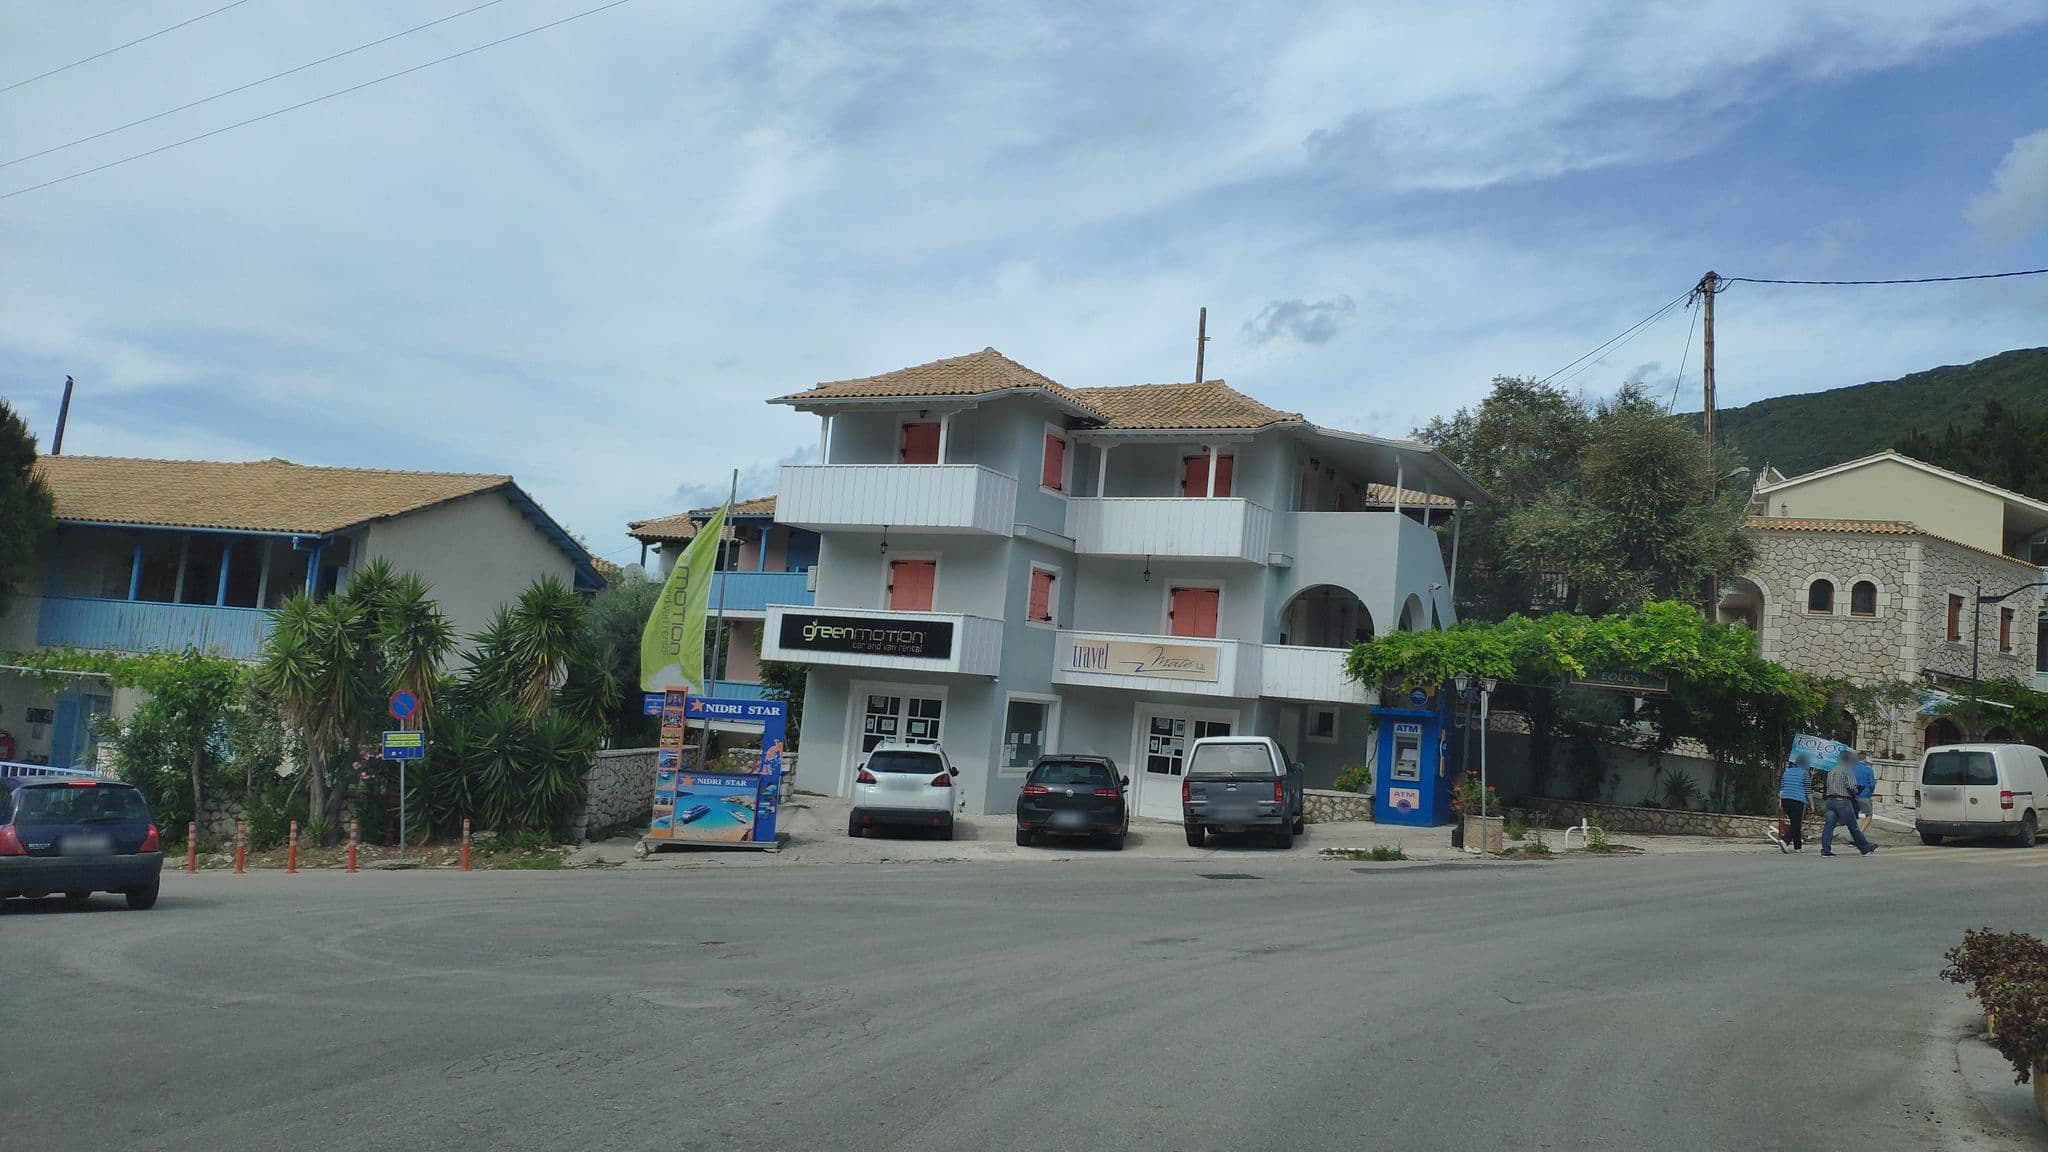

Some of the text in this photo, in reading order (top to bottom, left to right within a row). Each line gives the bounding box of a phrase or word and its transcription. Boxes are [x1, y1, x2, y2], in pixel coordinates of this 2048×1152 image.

[852, 641, 923, 654] car and van rental
[1072, 643, 1109, 670] travel
[705, 703, 780, 716] NIDRI STAR
[1396, 724, 1418, 733] ATM
[697, 777, 747, 787] NIDRI STAR
[1393, 791, 1416, 799] ATM
